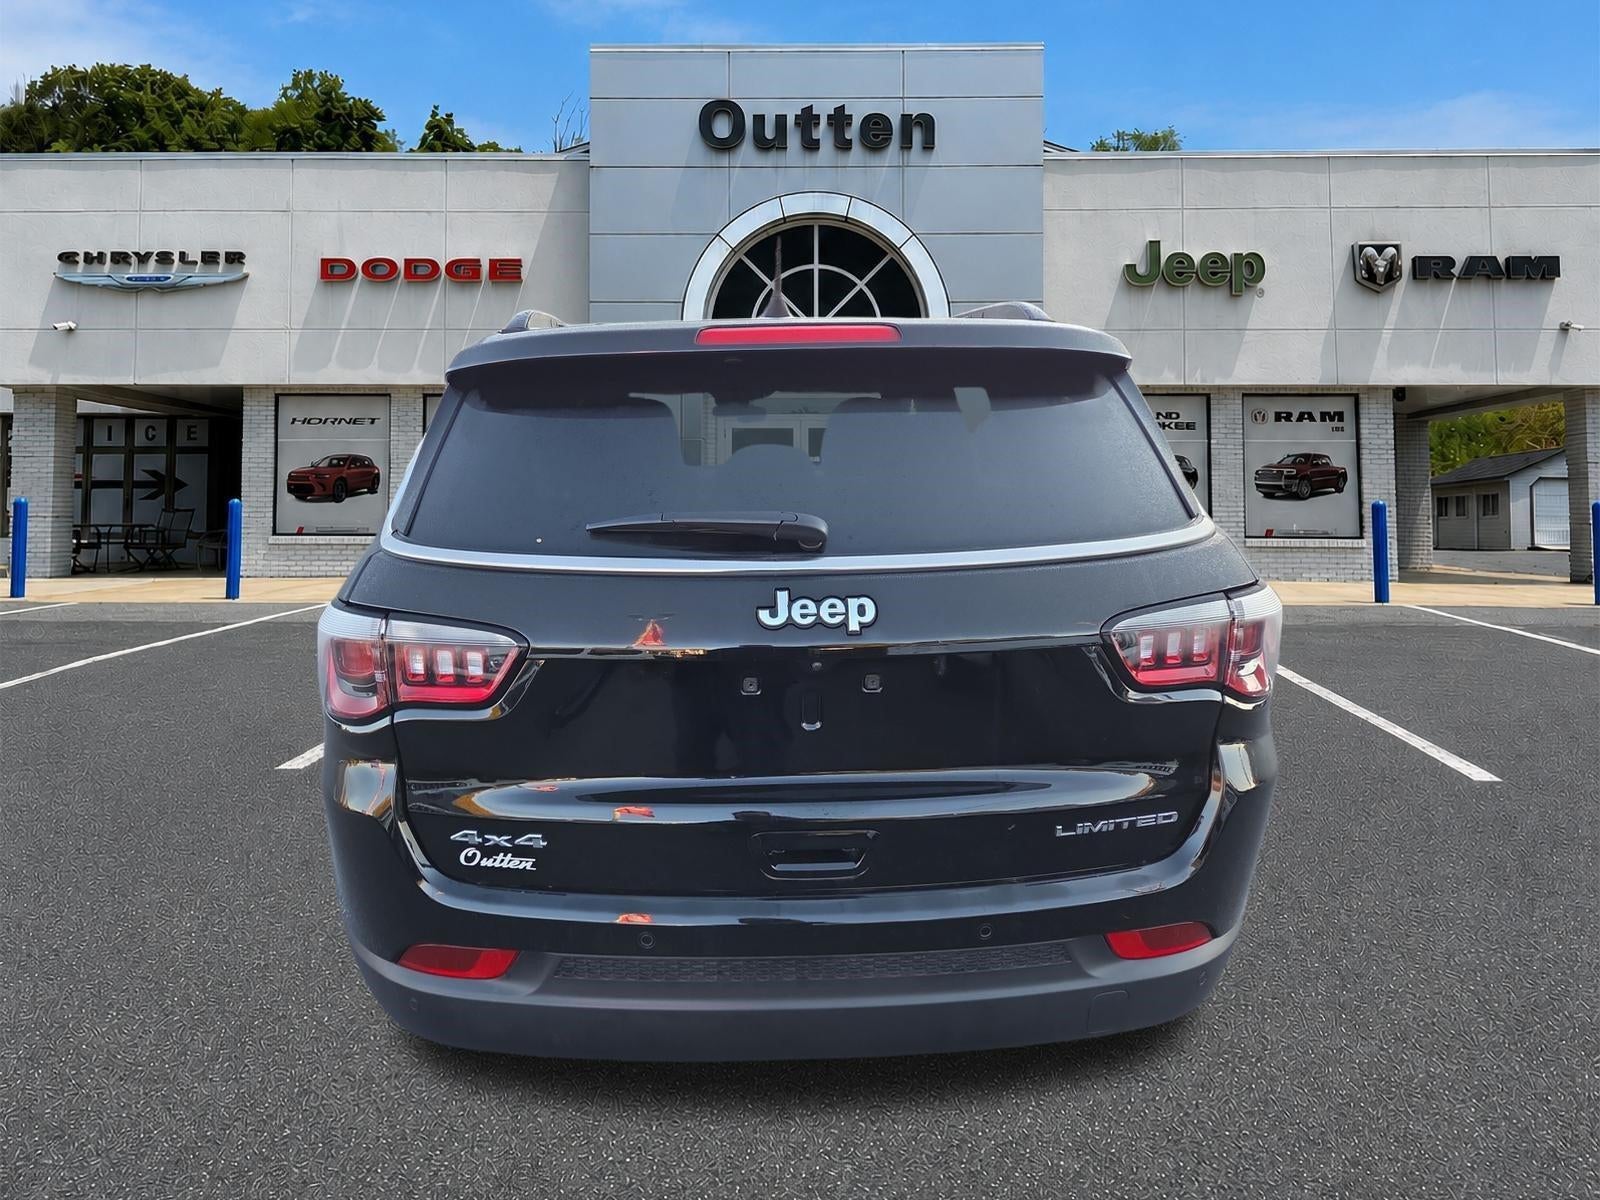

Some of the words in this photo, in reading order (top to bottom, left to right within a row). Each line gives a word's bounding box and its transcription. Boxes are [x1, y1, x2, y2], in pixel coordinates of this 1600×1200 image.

[699, 99, 936, 150] Outten
[56, 251, 246, 265] CHRYSLER
[320, 257, 523, 282] DODGE
[1123, 240, 1266, 296] Jeep
[1411, 255, 1561, 280] RAM
[290, 417, 381, 426] HORNET
[1274, 411, 1345, 423] RAM
[756, 588, 878, 635] Jeep
[1056, 811, 1179, 837] LIMITED
[459, 847, 537, 871] Outten
